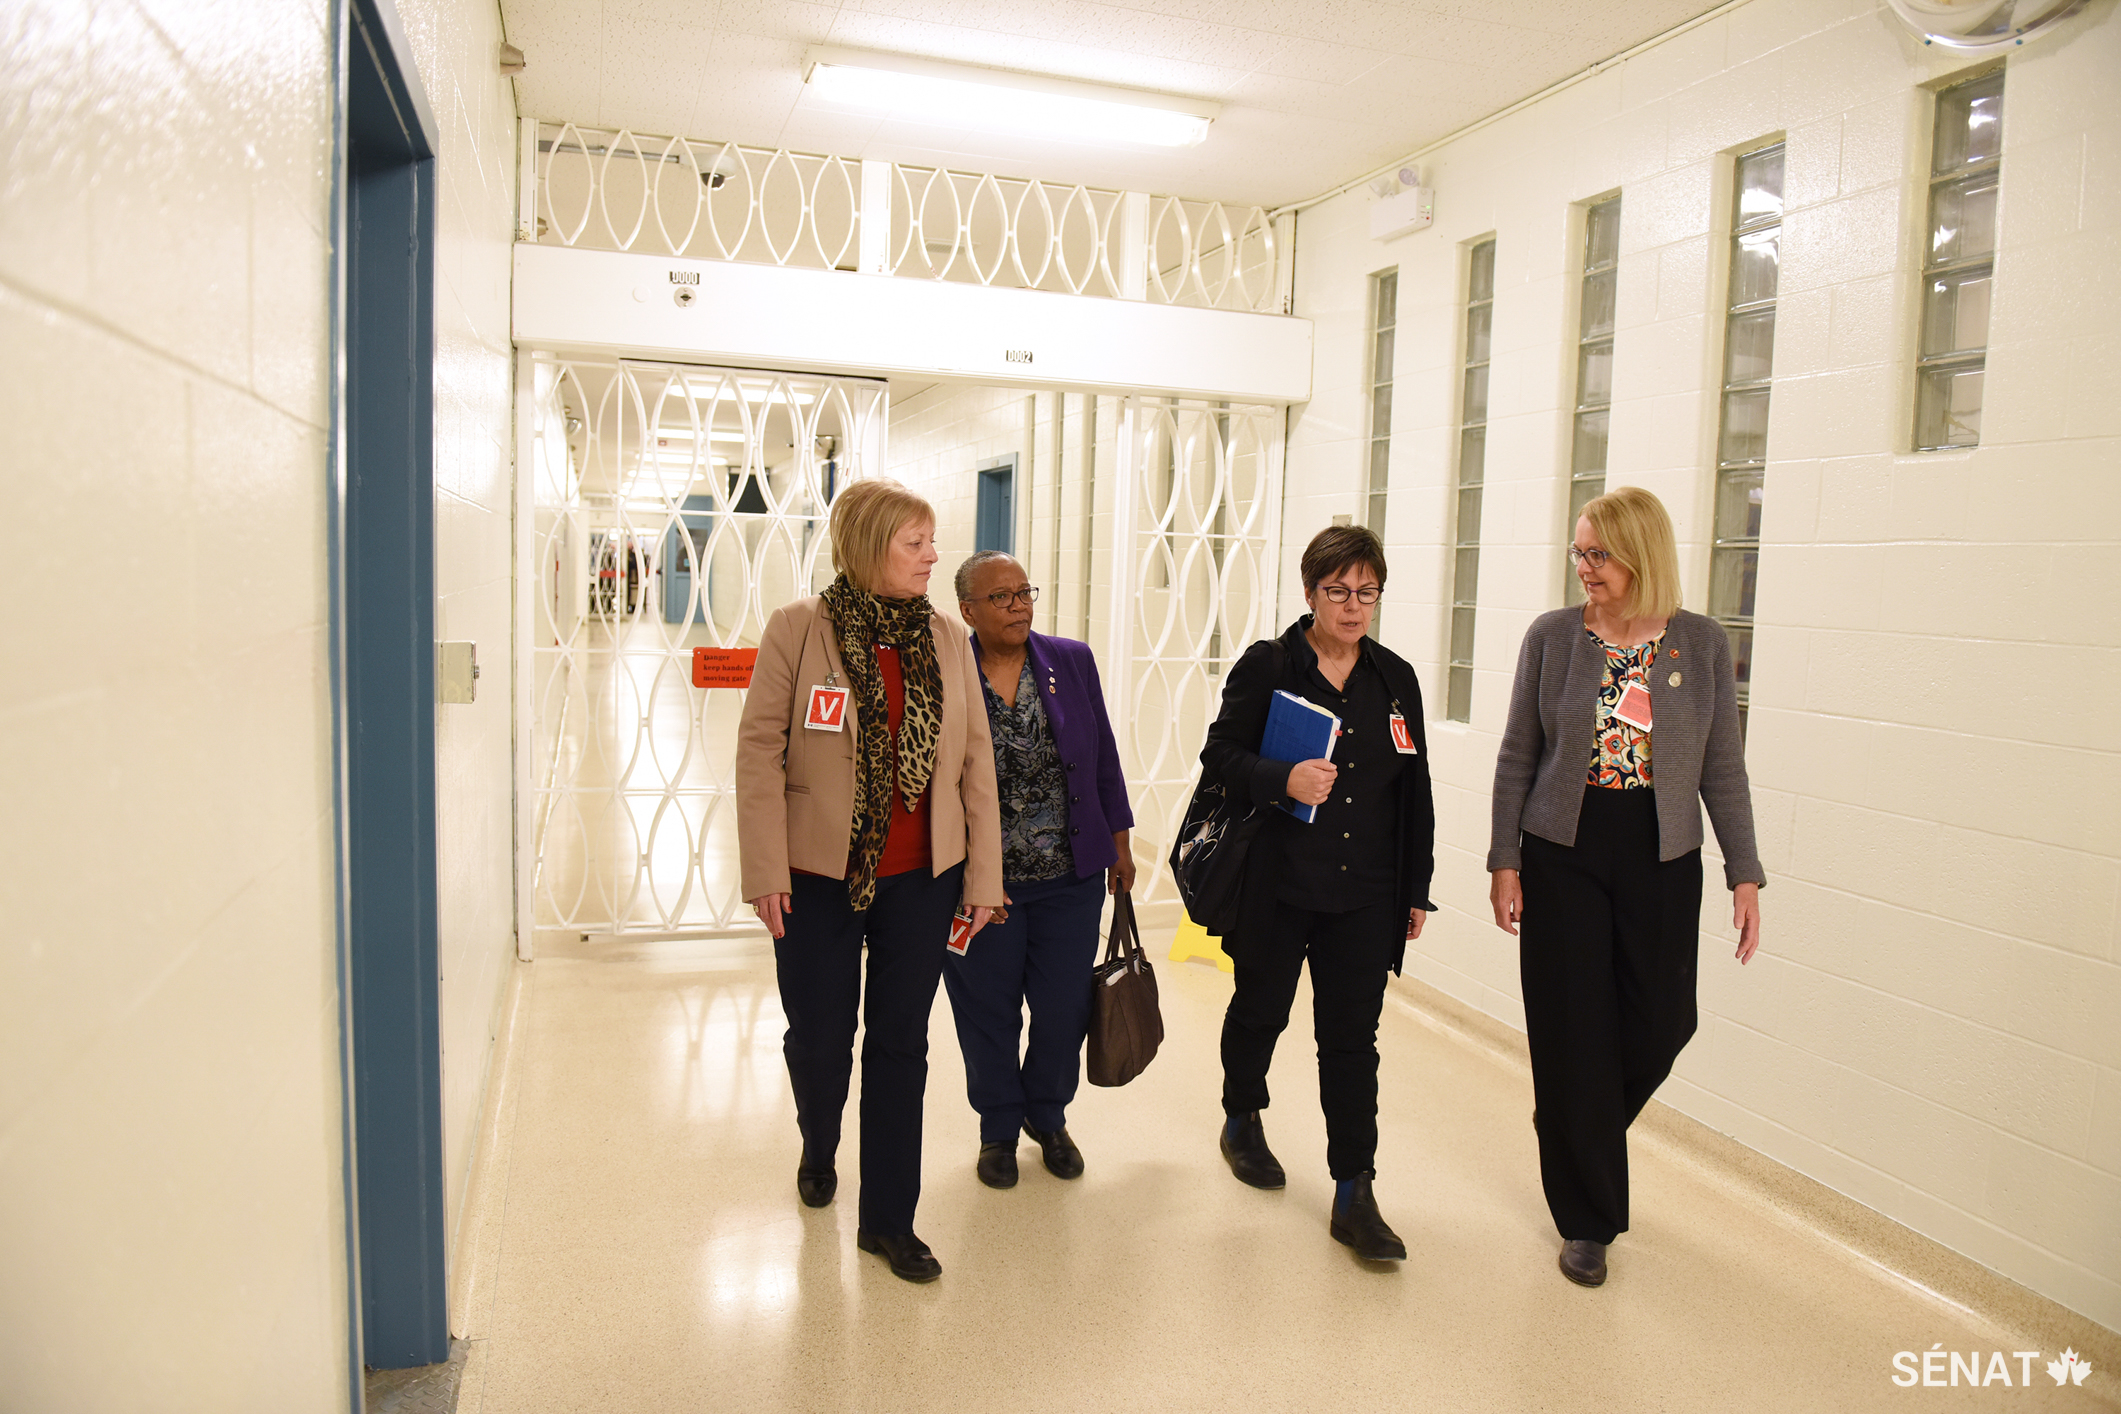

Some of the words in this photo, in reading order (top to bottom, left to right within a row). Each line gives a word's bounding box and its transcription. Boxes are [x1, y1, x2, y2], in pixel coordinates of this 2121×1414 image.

[819, 696, 840, 721] V
[1395, 724, 1407, 746] V
[949, 922, 967, 944] V
